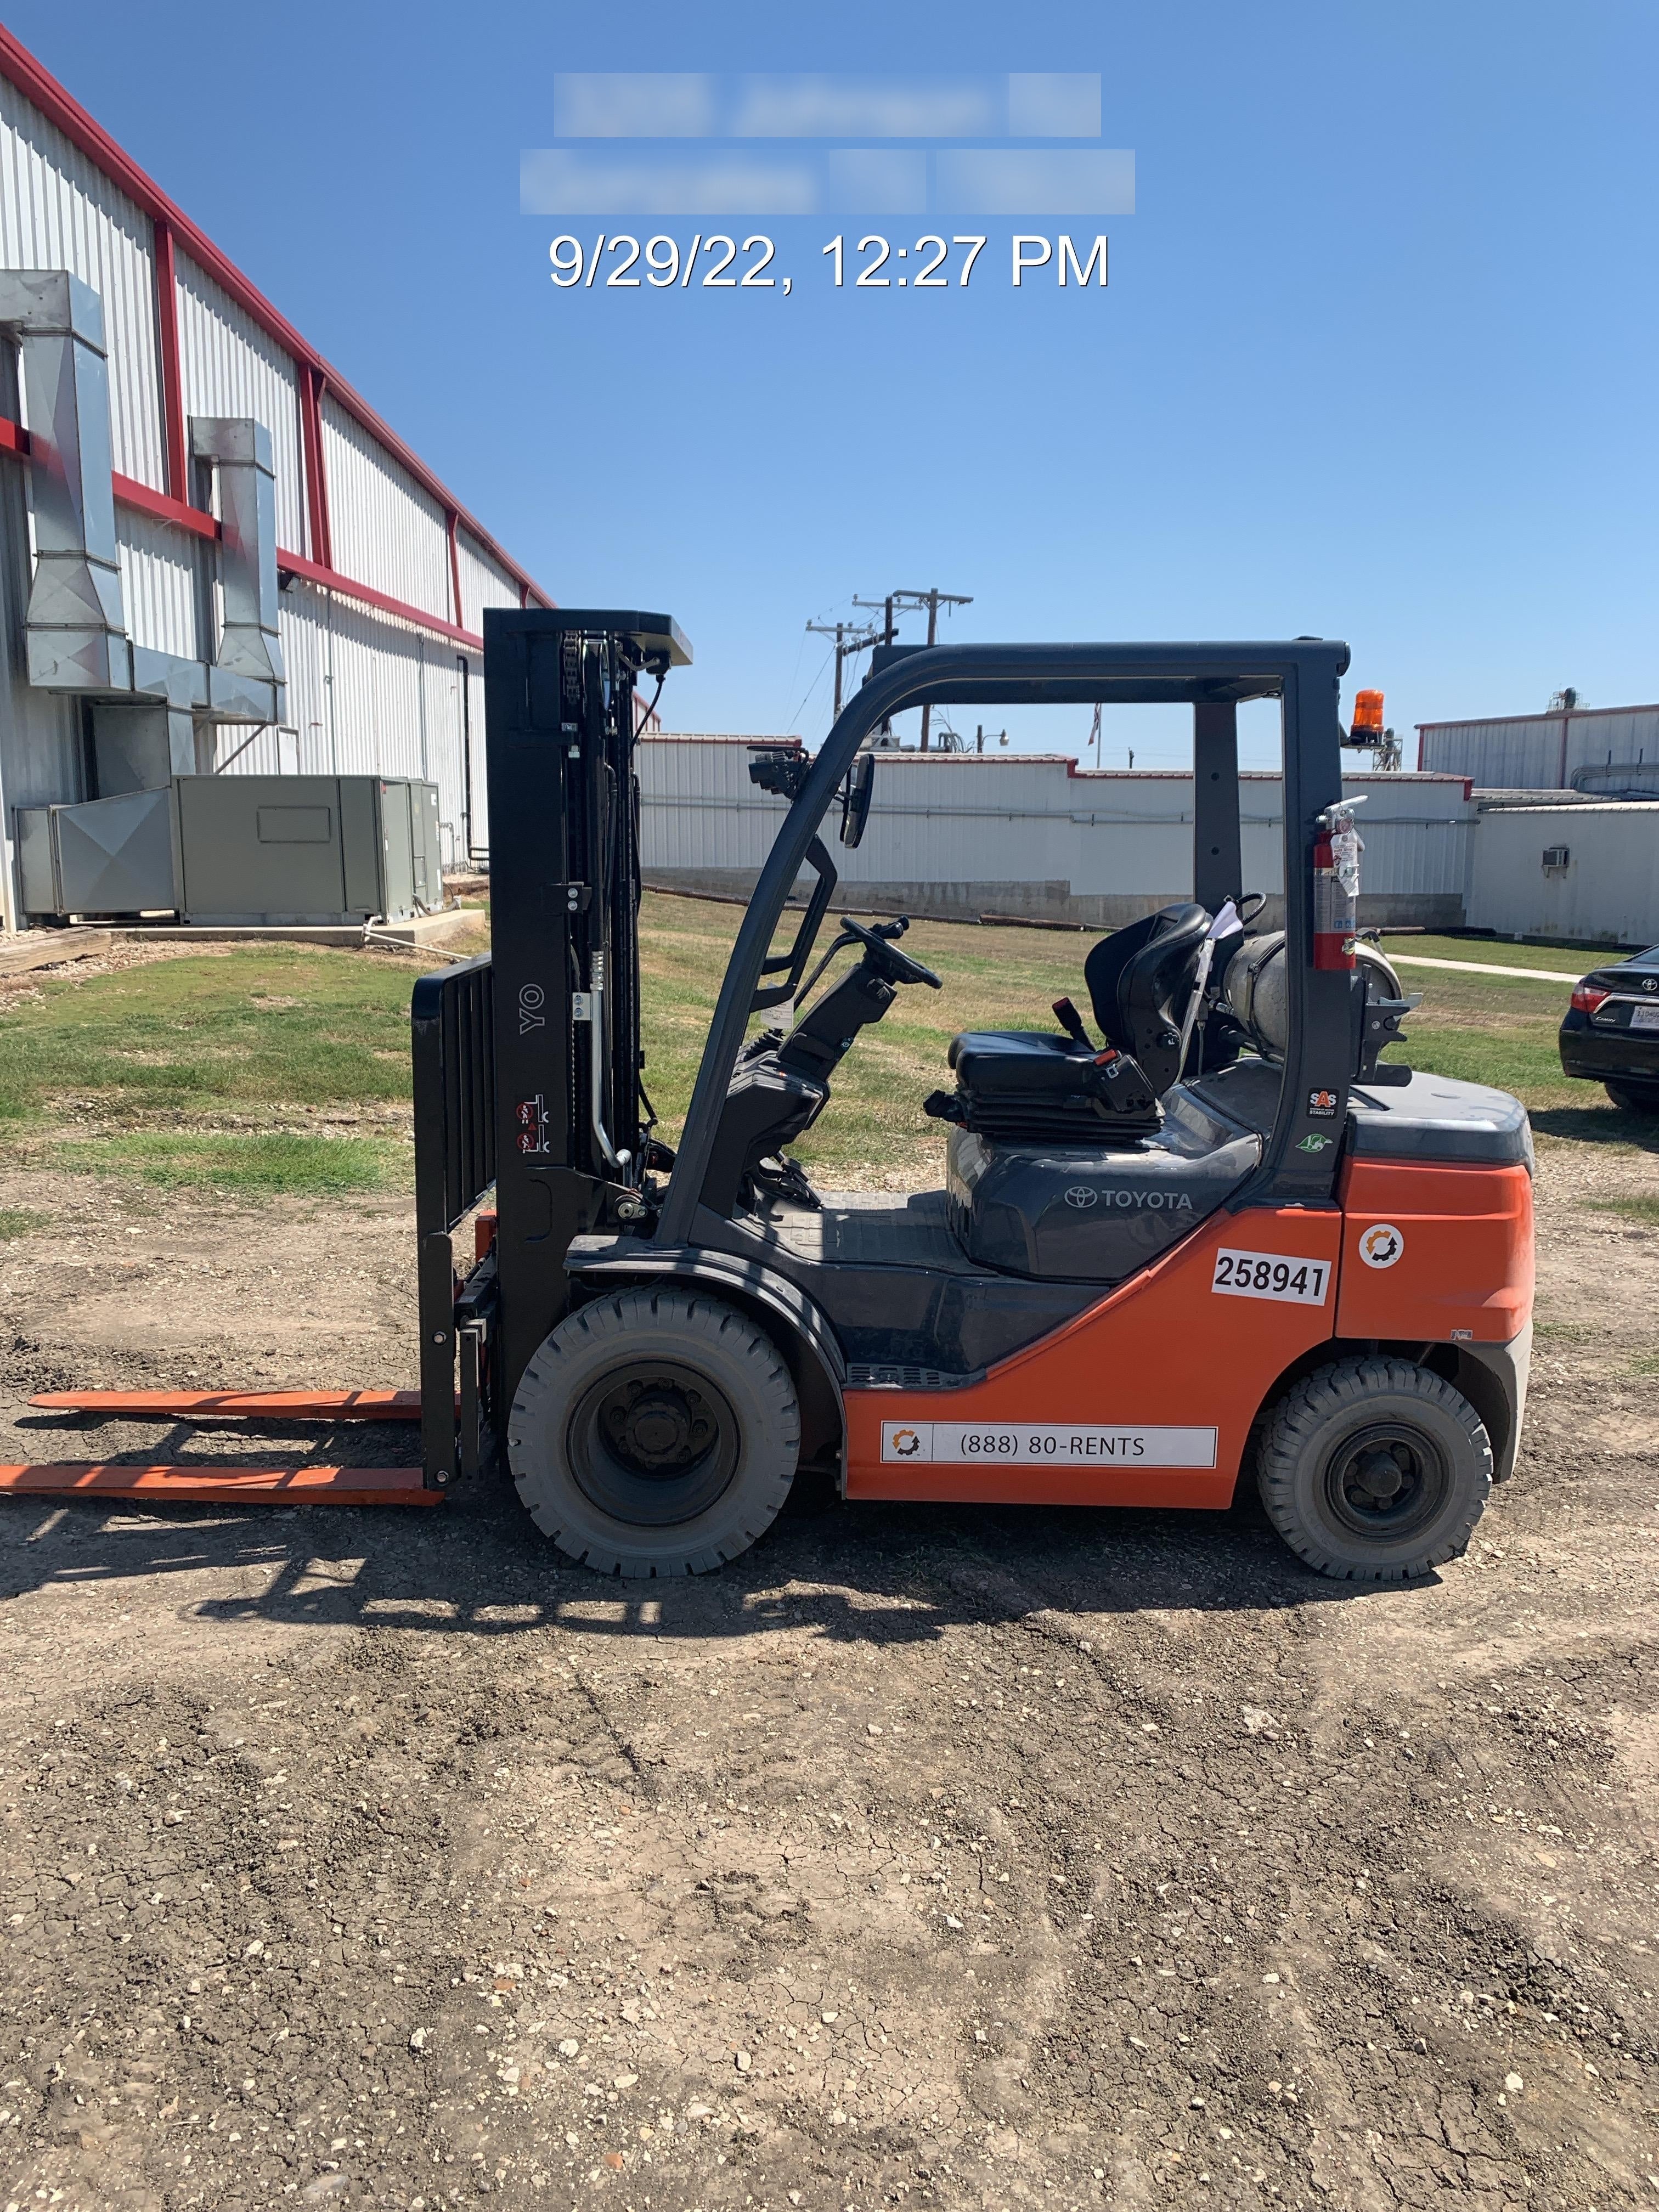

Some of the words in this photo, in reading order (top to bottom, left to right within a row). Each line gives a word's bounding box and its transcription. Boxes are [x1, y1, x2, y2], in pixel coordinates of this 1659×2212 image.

[1310, 1091, 1337, 1108] SAS
[1101, 1189, 1193, 1210] TOYOTA
[1215, 1256, 1323, 1296] 258941
[960, 1434, 1019, 1457] (888)
[1028, 1436, 1144, 1456] 80-RENTS
